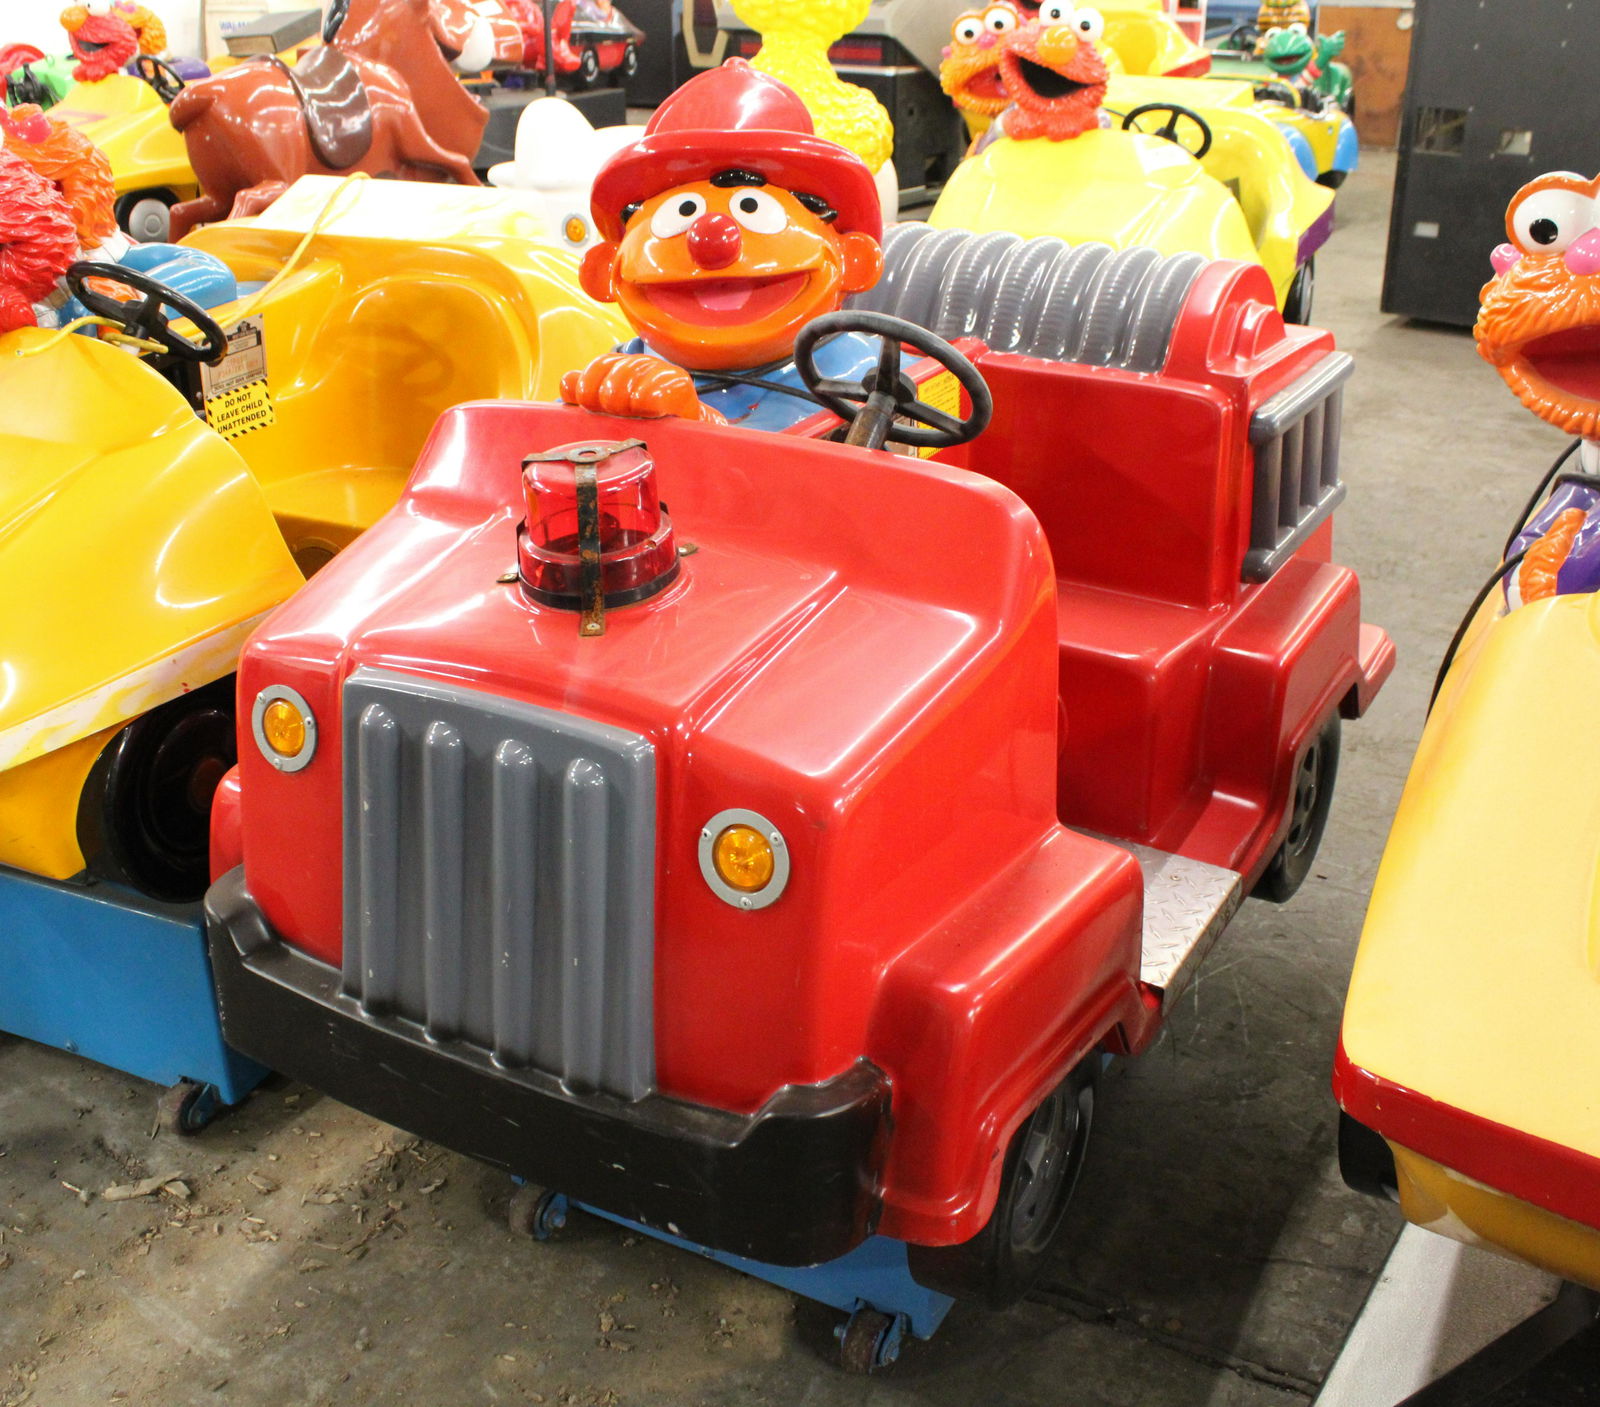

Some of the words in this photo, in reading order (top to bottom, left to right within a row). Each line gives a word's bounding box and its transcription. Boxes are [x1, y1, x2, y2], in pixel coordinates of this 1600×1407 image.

[217, 408, 239, 422] LEAVE
[241, 399, 263, 413] CHILD
[225, 398, 235, 408] DO
[237, 392, 251, 403] NOT
[217, 410, 267, 433] UNATTENDED
